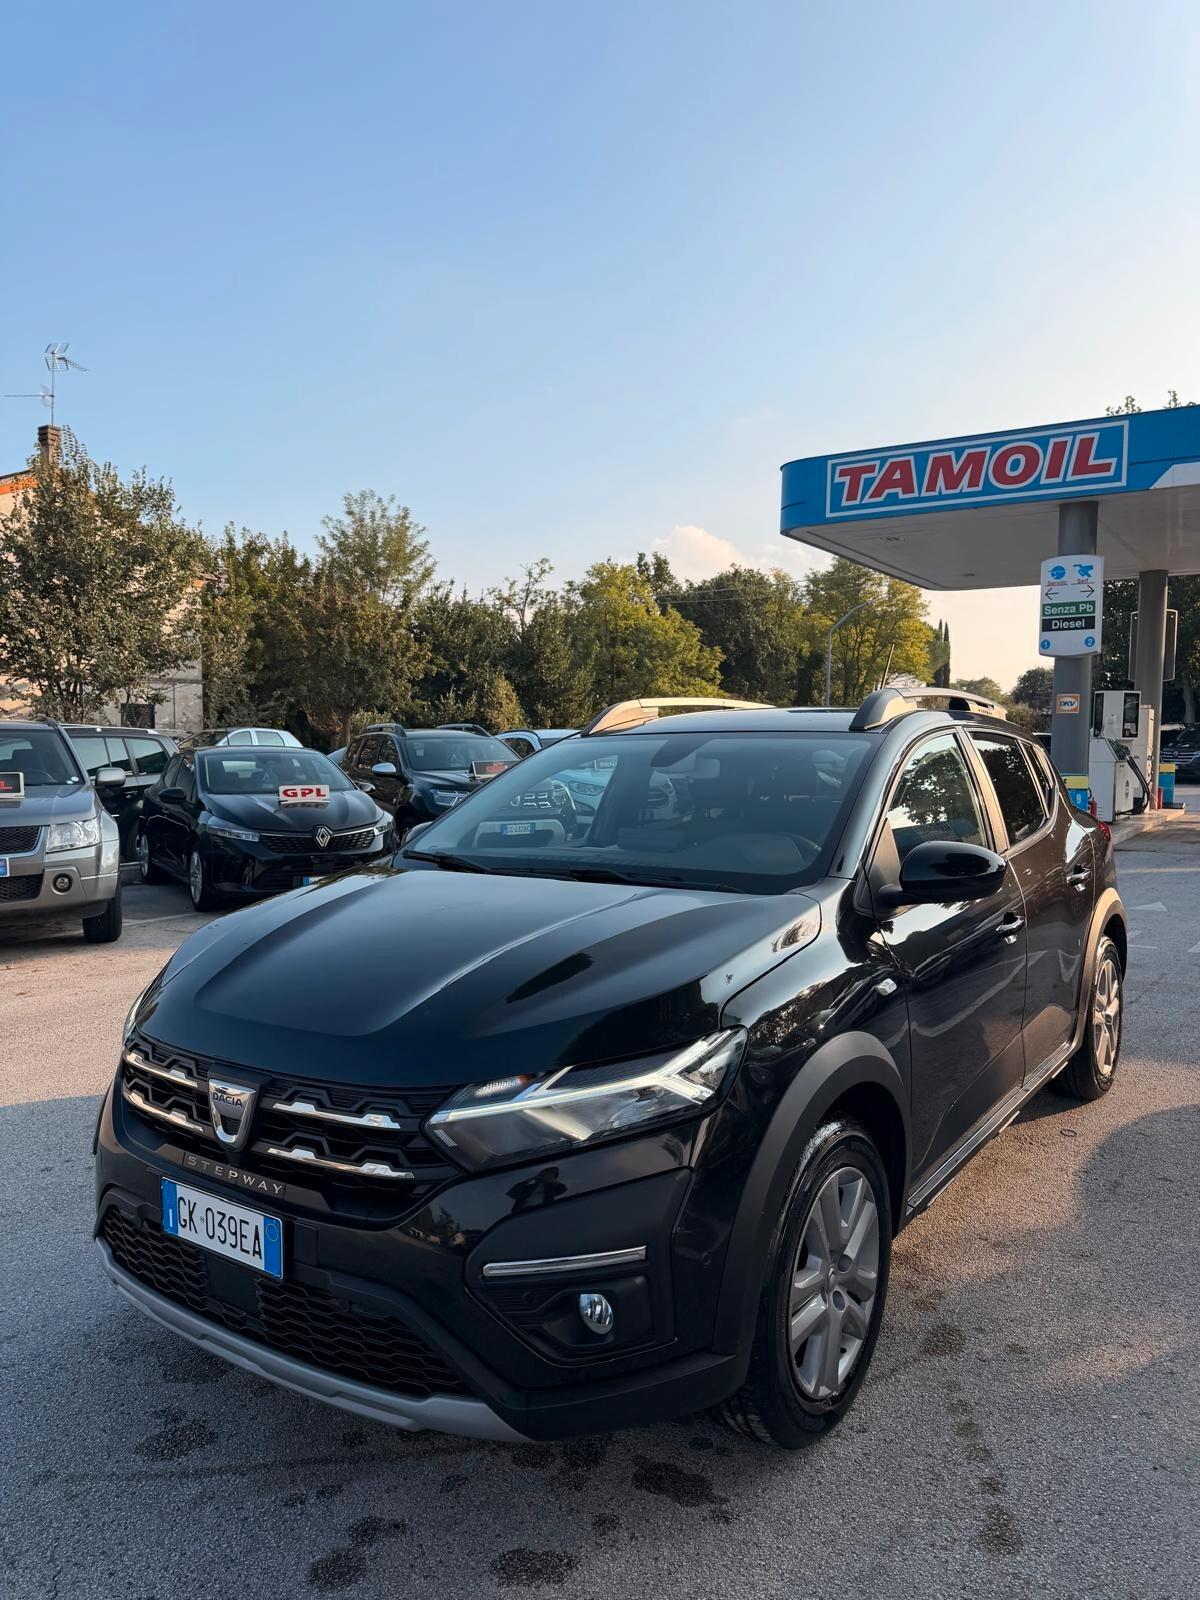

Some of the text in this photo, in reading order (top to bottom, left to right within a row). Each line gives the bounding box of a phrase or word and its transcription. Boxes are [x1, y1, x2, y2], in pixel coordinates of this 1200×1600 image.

[835, 433, 1116, 505] TAMOIL
[1044, 603, 1094, 615] Senza Pb
[1051, 618, 1085, 629] Diesel
[282, 787, 327, 798] GPL
[212, 1091, 244, 1108] DACIA
[186, 1155, 283, 1195] STEPWAY
[177, 1195, 263, 1260] GK 039EA
